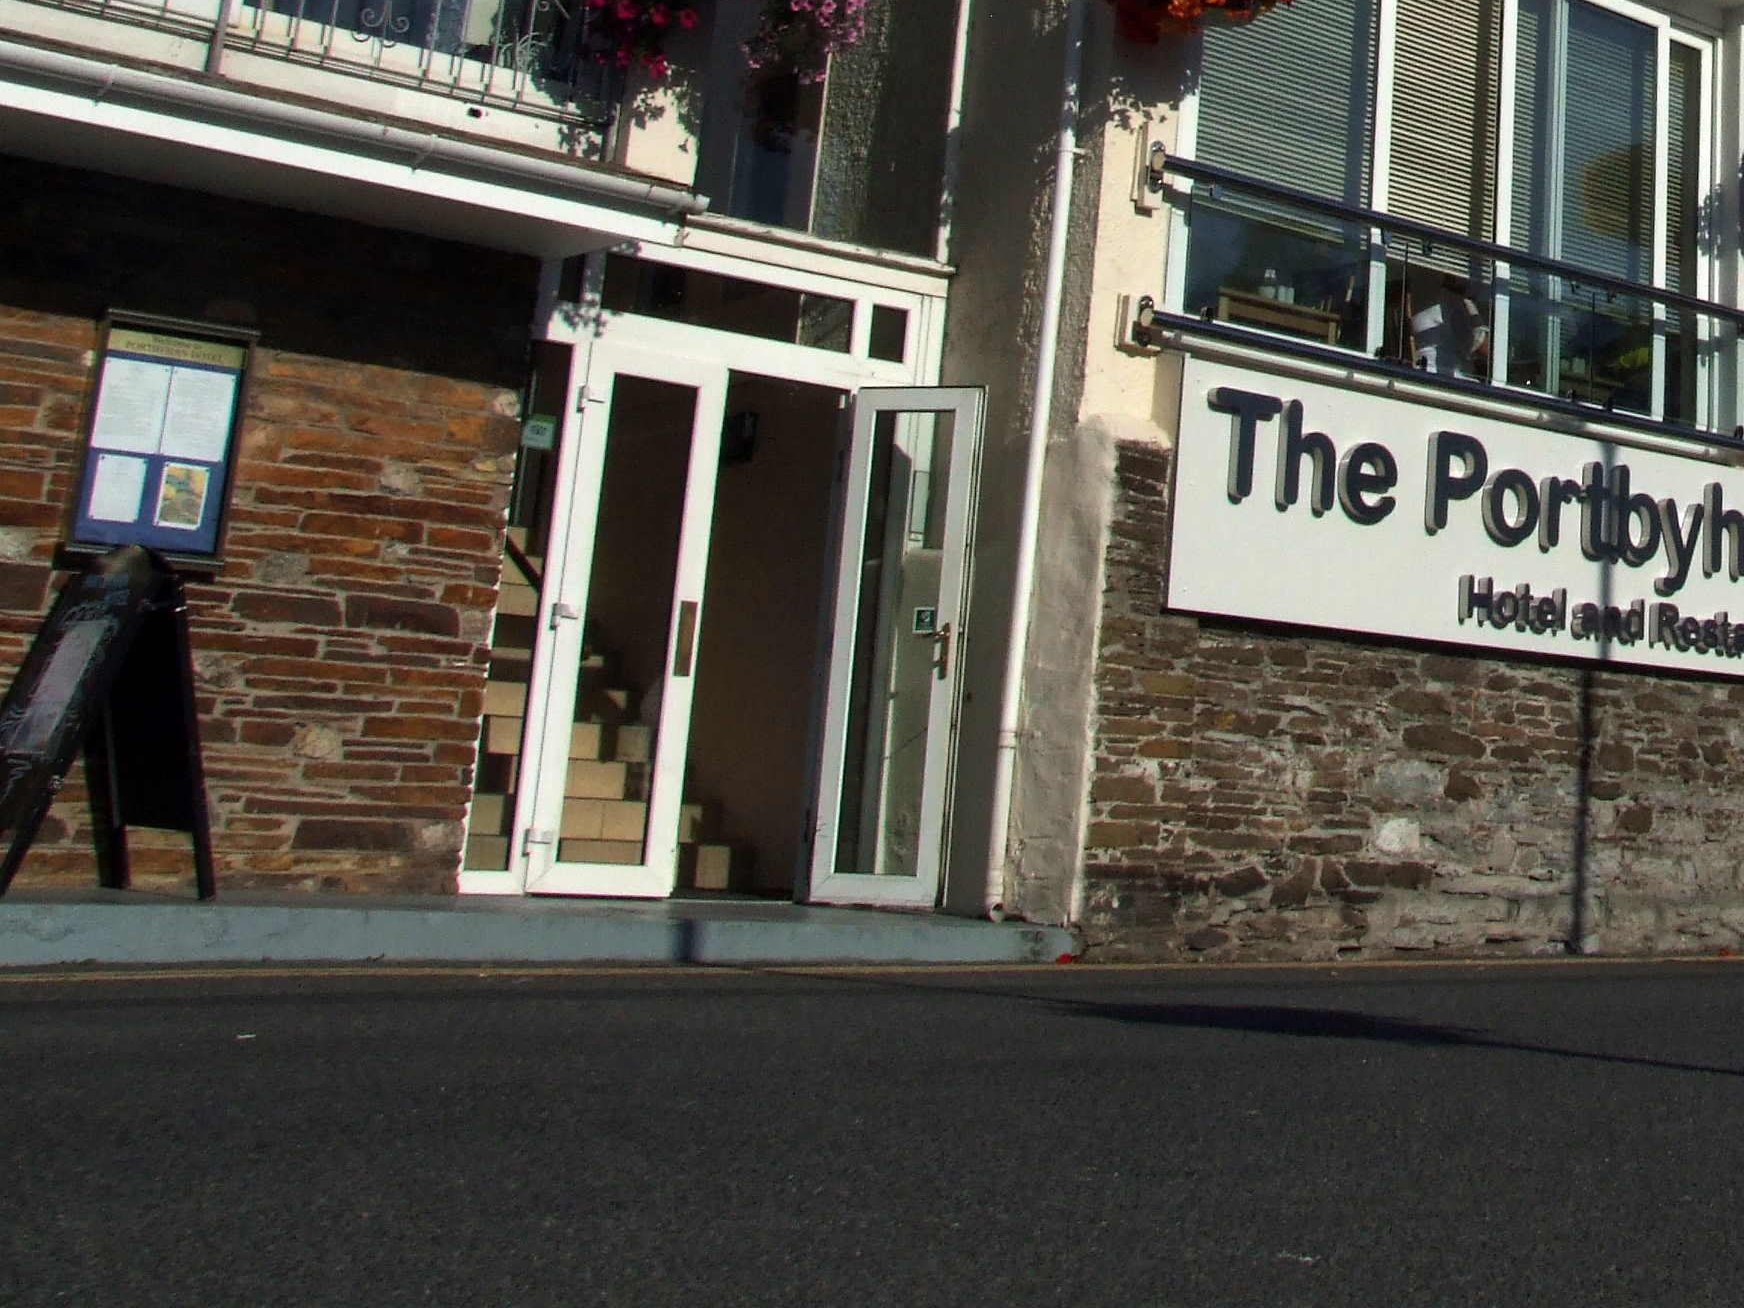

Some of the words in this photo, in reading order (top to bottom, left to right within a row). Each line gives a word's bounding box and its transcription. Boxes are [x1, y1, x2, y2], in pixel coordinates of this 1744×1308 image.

[1207, 385, 1399, 526] The
[1457, 573, 1568, 637] Hotel
[1570, 599, 1646, 646] and
